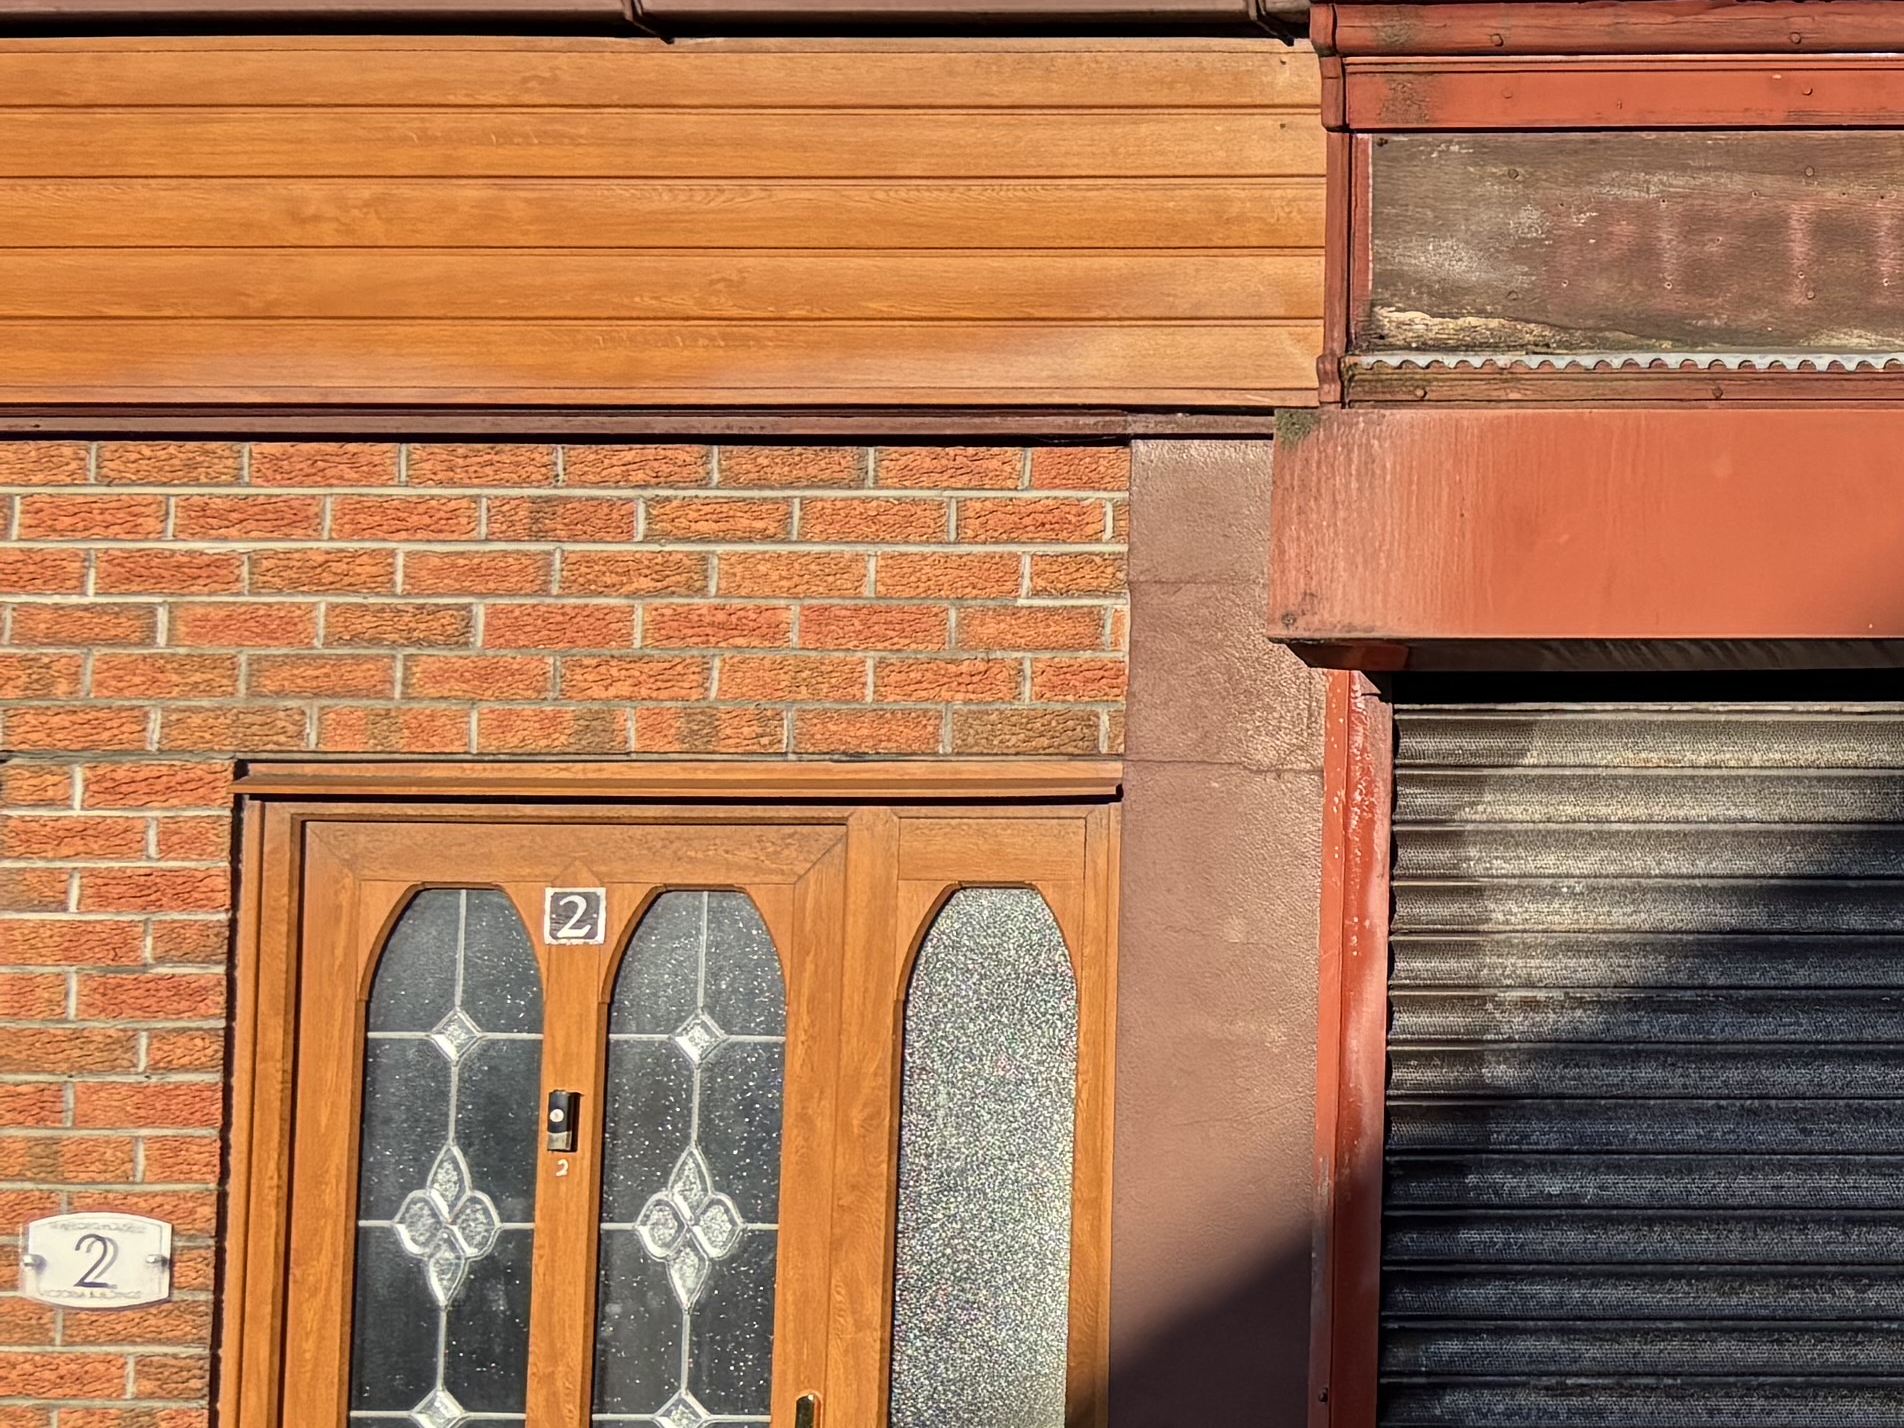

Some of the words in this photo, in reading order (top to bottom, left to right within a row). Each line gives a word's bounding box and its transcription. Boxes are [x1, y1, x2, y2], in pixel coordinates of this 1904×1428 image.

[556, 894, 592, 939] 2
[555, 1158, 569, 1176] 2
[73, 1233, 110, 1288] 2
